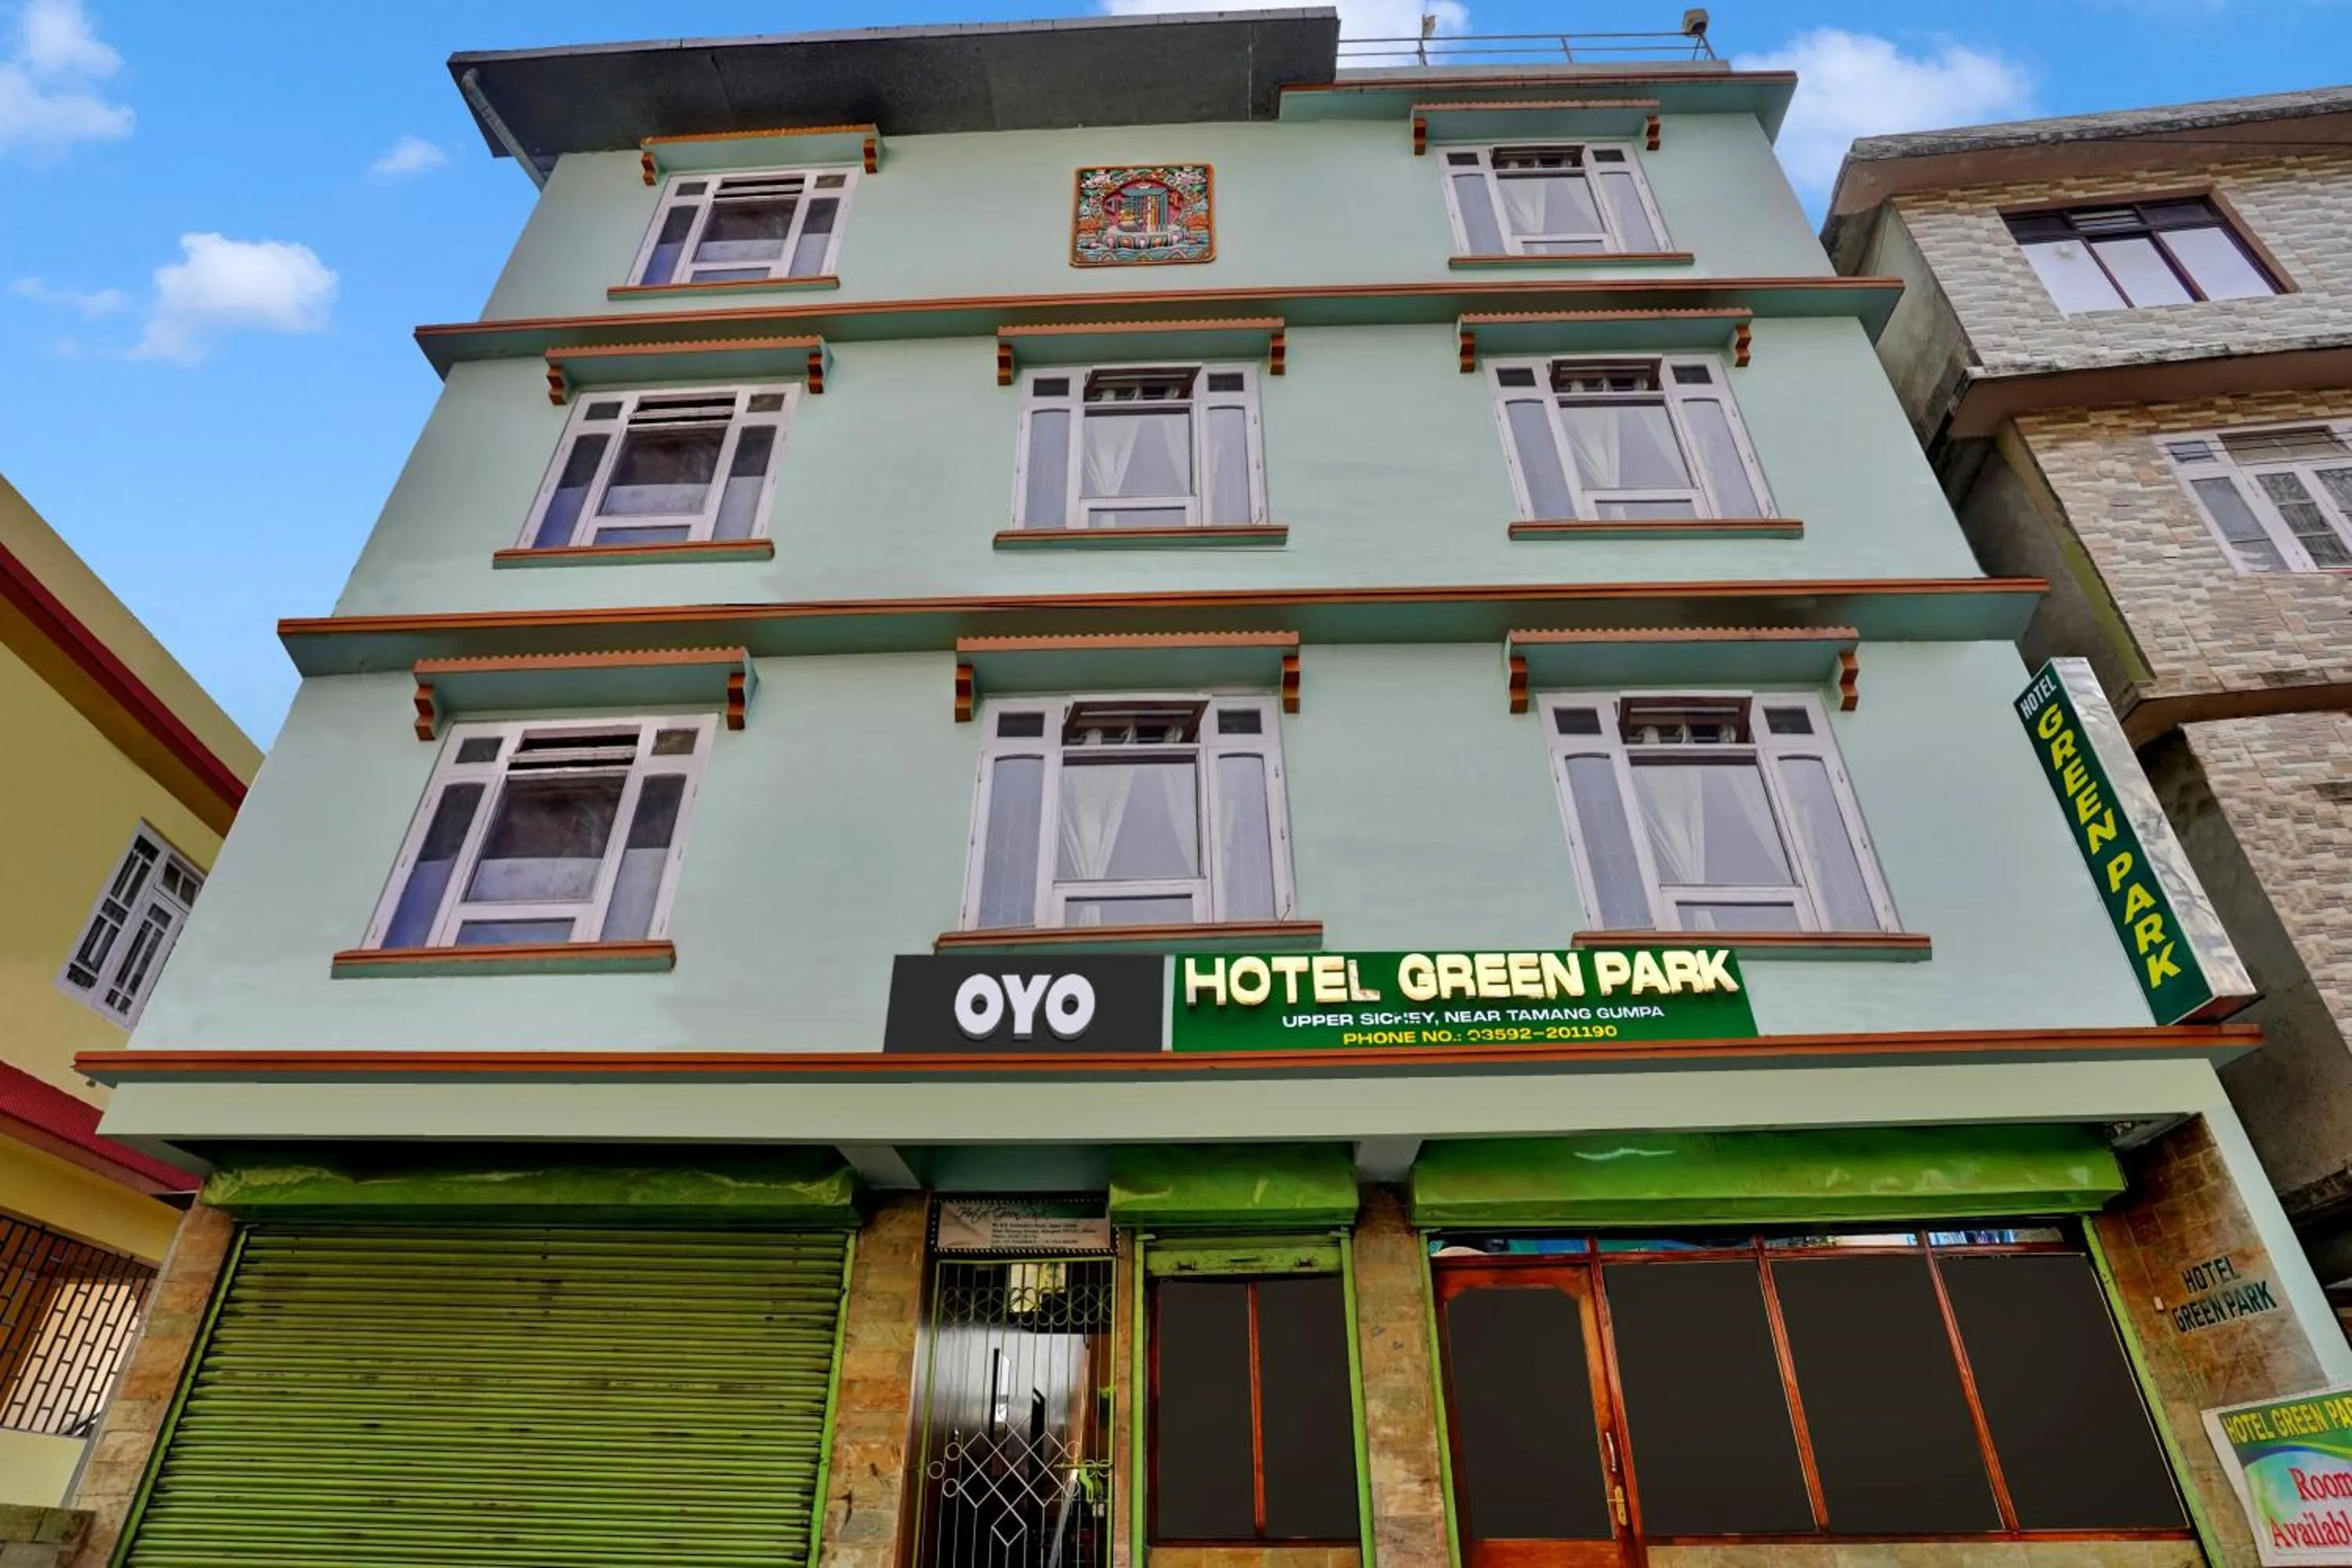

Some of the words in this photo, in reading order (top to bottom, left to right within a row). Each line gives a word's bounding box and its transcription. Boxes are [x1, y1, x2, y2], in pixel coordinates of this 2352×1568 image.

[2020, 674, 2056, 719] HOTEL
[2038, 702, 2117, 855] GREEN
[2107, 851, 2182, 989] PARK
[1185, 956, 1381, 1006] HOTEL
[1398, 952, 1585, 1002] GREEN
[1594, 949, 1740, 996] PARK
[954, 973, 1095, 1040] OYO
[1282, 1014, 1354, 1028] UPPER
[1444, 1011, 1501, 1023] NEAR
[1506, 1007, 1592, 1021] TAMANG
[1596, 1006, 1665, 1019] GUMPA
[1343, 1031, 1416, 1045] PHONE
[1467, 1025, 1617, 1042] 03592-201190
[2182, 1255, 2241, 1294] HOTEL
[2171, 1294, 2227, 1333] GREEN
[2223, 1280, 2278, 1318] PARK
[2223, 1412, 2276, 1444] HOTEL
[2270, 1403, 2329, 1438] GREEN
